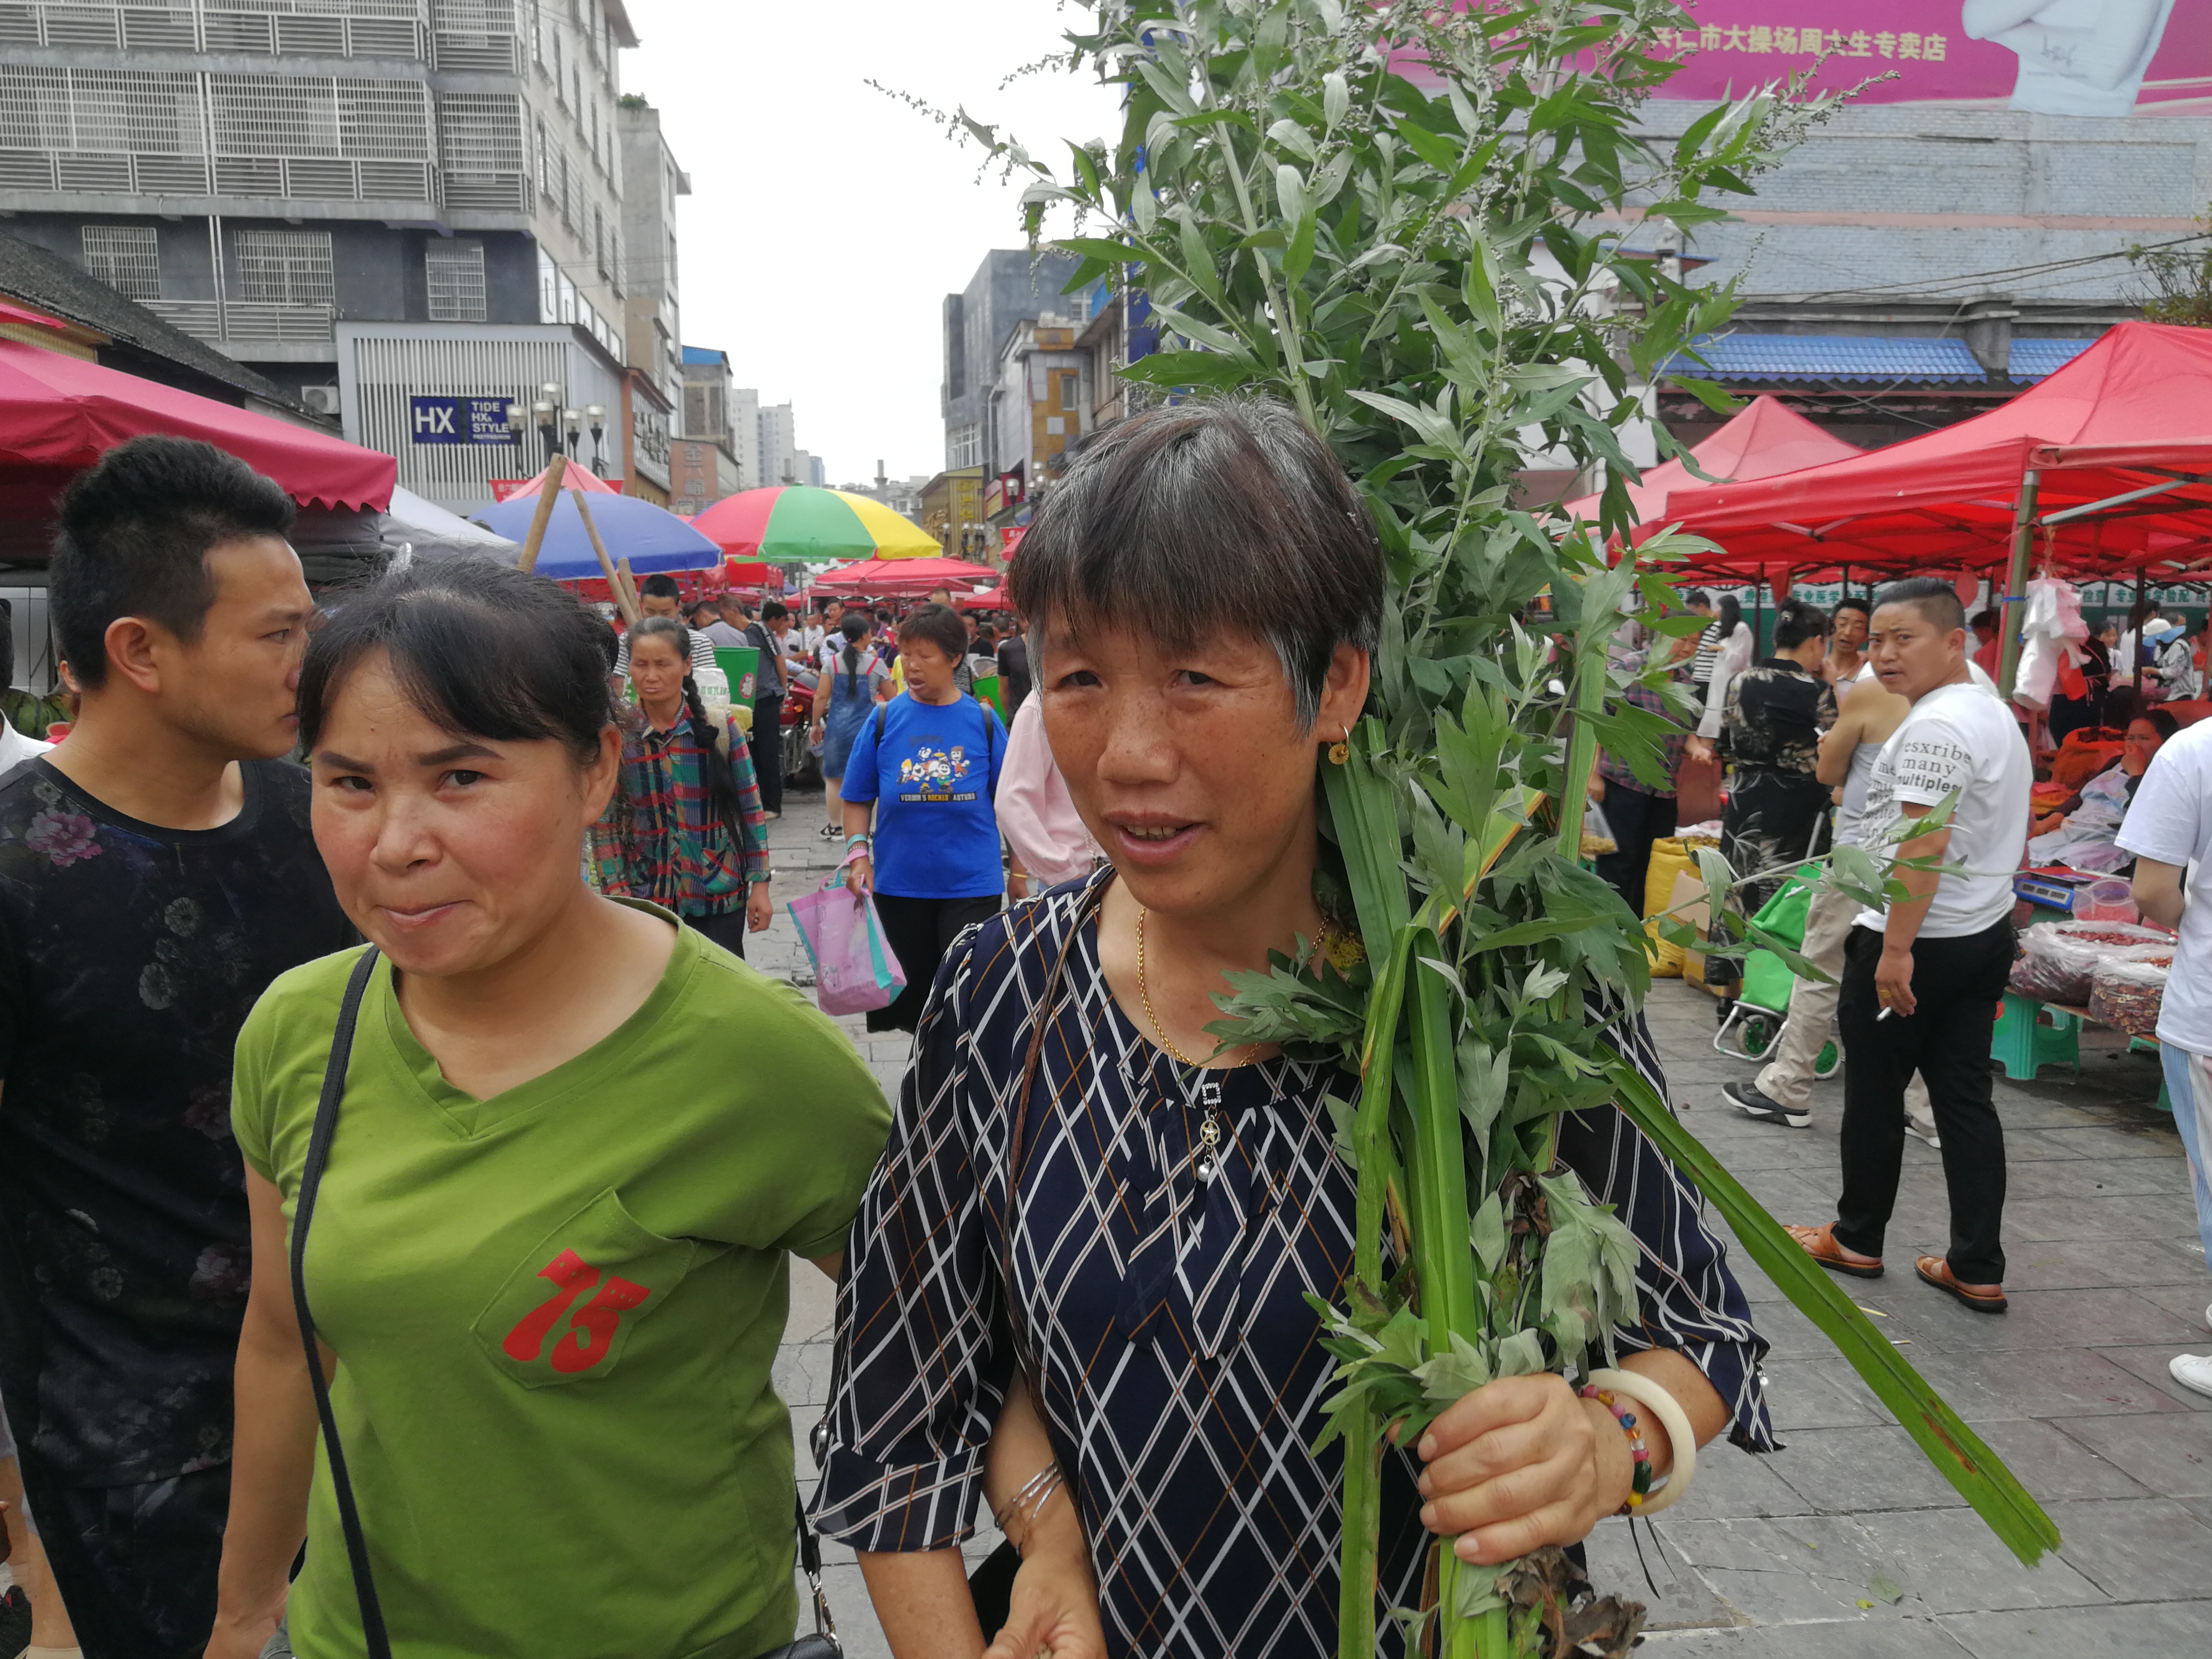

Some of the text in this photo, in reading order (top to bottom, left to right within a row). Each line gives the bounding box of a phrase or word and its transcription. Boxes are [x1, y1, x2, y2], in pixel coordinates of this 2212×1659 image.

[471, 401, 501, 413] TIDE
[415, 406, 455, 434] HX
[472, 422, 510, 433] STYLE
[1902, 758, 1956, 778] many
[502, 1248, 651, 1374] 75
